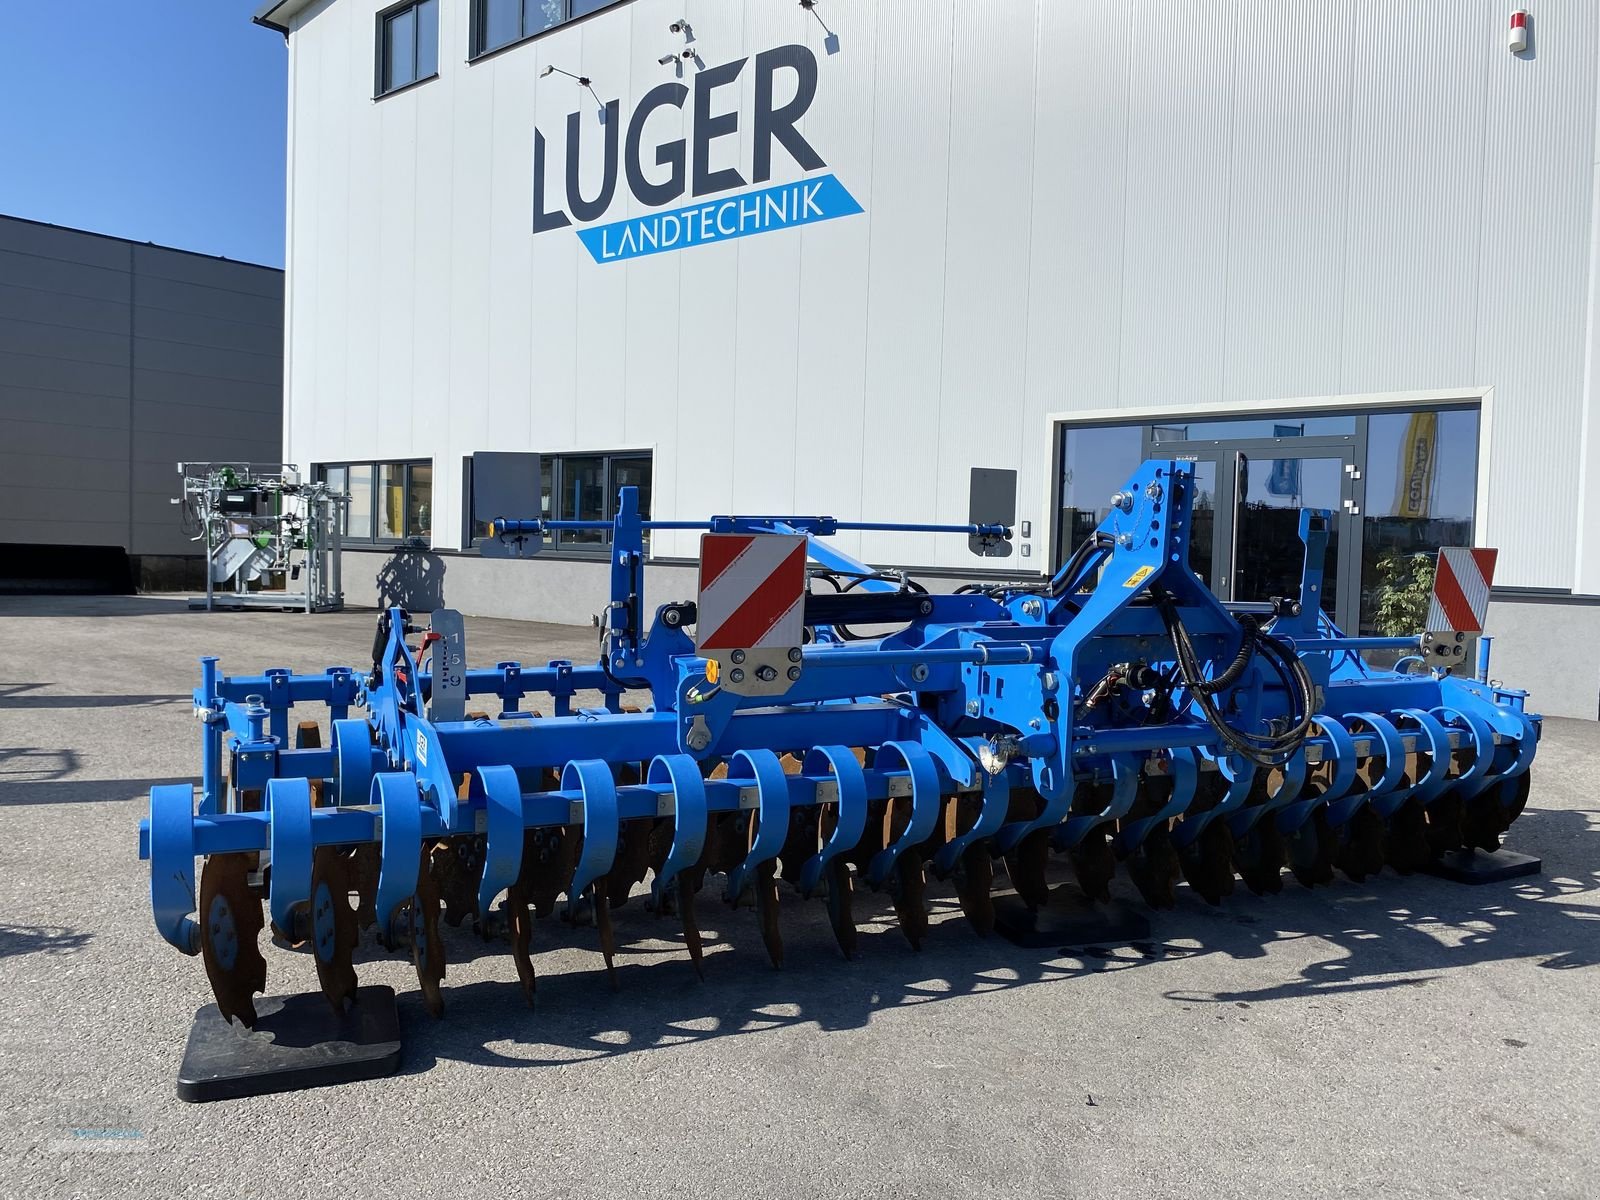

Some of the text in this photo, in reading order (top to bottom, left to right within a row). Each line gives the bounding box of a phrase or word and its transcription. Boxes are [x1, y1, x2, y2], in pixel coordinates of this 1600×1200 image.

[533, 44, 827, 234] LUGER
[602, 182, 824, 259] LANDTECHNIK
[452, 633, 459, 644] 1
[451, 653, 461, 665] 5
[450, 675, 461, 687] 9
